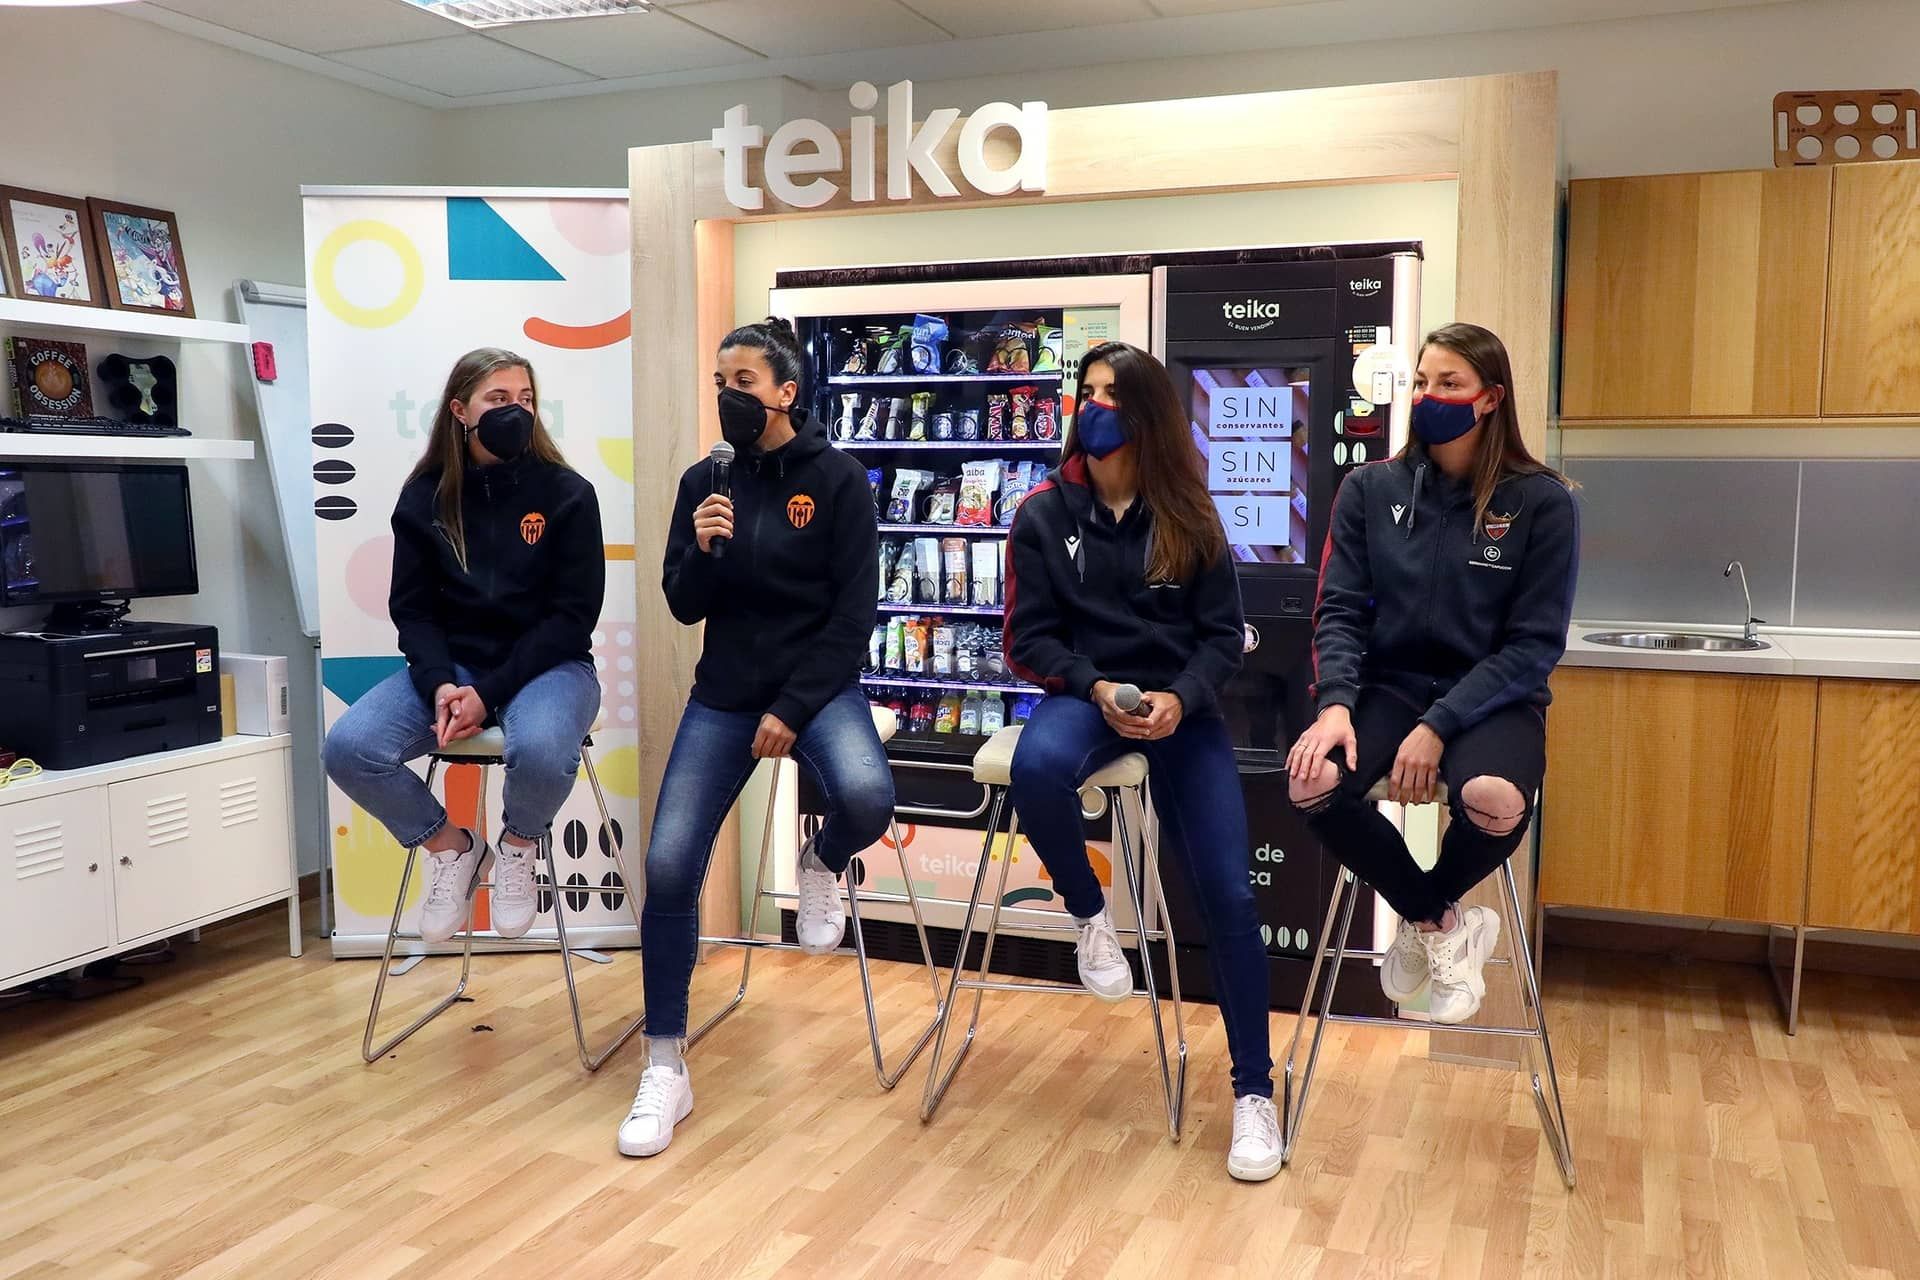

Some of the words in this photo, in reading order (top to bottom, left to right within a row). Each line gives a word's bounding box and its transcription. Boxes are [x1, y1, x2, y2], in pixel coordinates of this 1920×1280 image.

[711, 79, 1048, 210] teika
[1349, 278, 1382, 290] teika
[1222, 298, 1280, 319] teika
[30, 350, 73, 369] COFFEE
[30, 384, 82, 410] OBSESSION
[1222, 396, 1277, 419] SIN
[1216, 422, 1285, 430] conservantes
[1221, 450, 1276, 473] SIN
[1226, 475, 1272, 484] azúcares
[1233, 505, 1261, 527] SI
[1255, 843, 1285, 863] de
